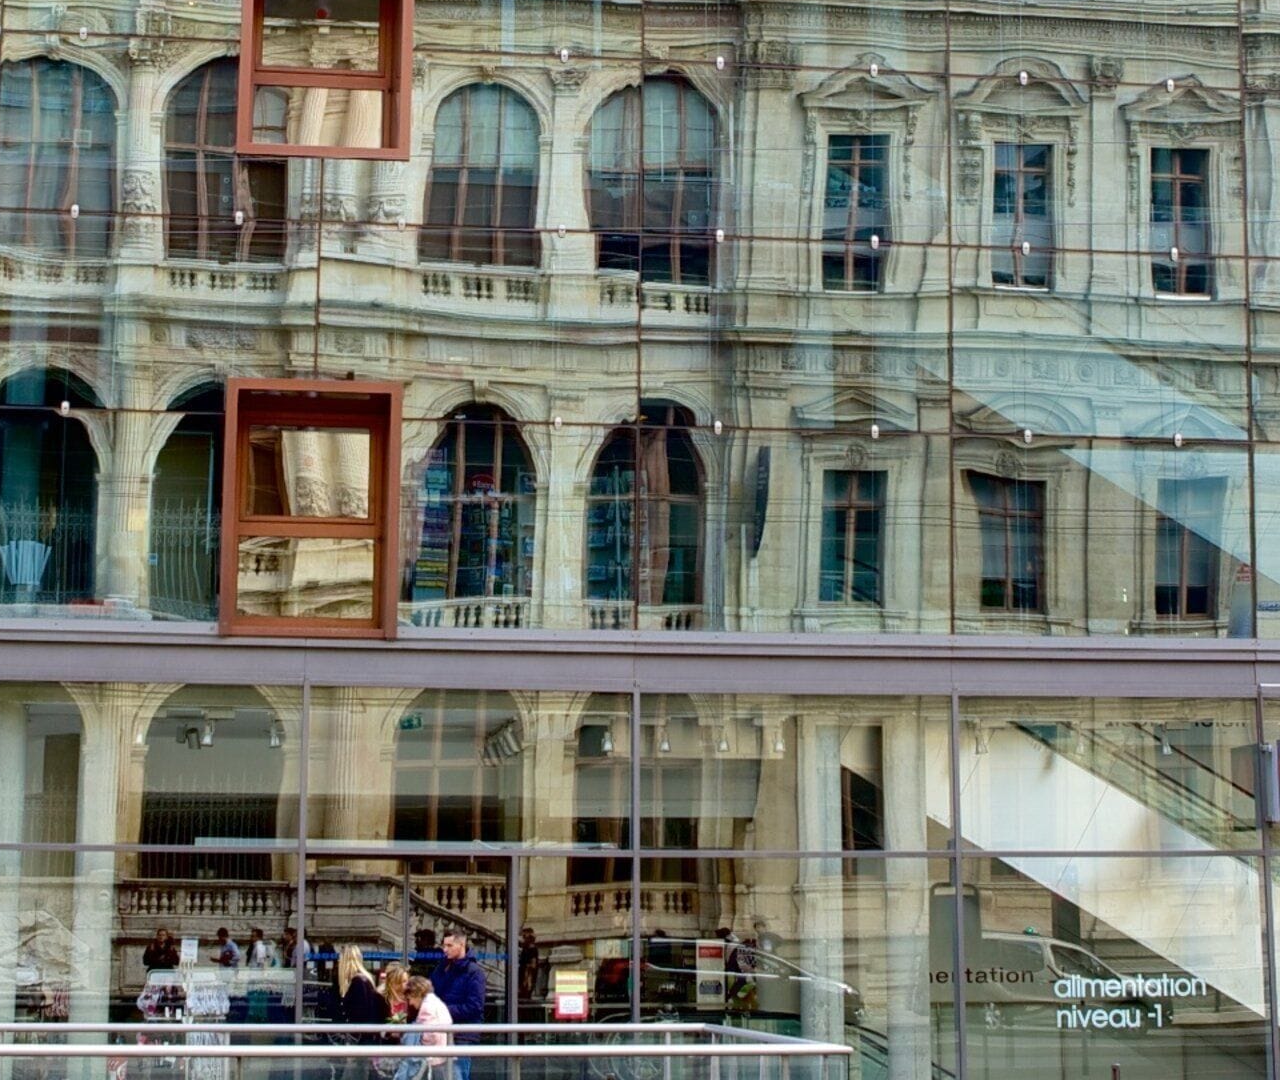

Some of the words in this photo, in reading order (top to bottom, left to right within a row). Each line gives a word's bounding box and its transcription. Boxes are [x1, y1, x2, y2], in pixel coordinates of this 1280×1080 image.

[1053, 973, 1207, 998] alimentation
[1056, 1004, 1141, 1028] niveau
[1147, 1003, 1163, 1028] -1
